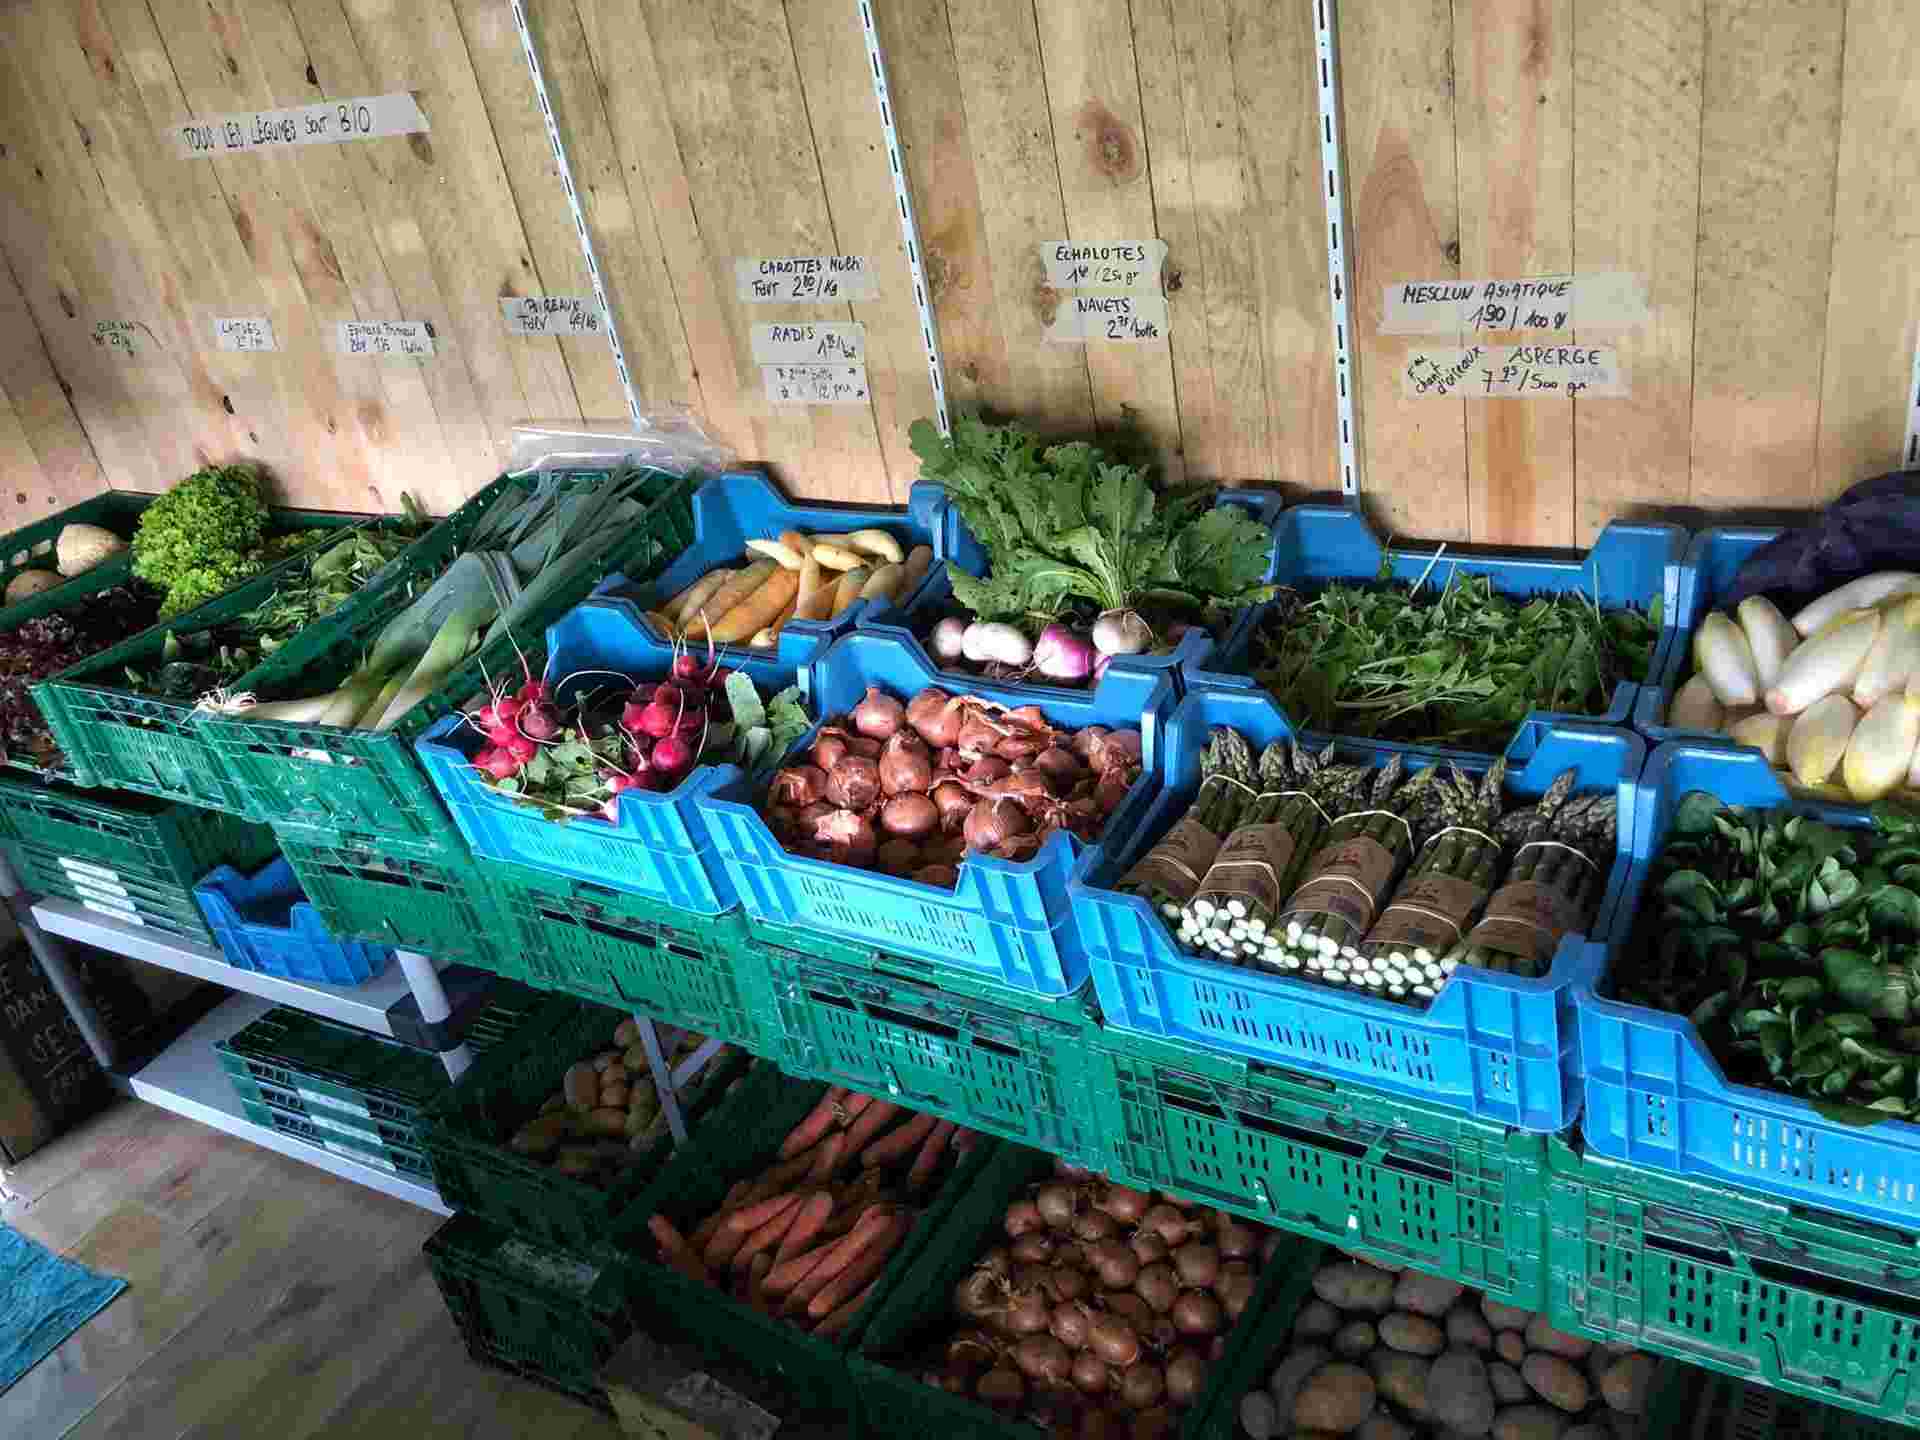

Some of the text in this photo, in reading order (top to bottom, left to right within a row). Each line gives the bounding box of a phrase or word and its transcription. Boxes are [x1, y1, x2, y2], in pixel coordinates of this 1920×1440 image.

[337, 105, 370, 132] BIO
[1403, 281, 1570, 304] MESCLUN ASIATIQUE
[1078, 297, 1131, 313] NAVETS
[773, 326, 817, 343] RADIS
[1509, 347, 1601, 367] ASPERGE
